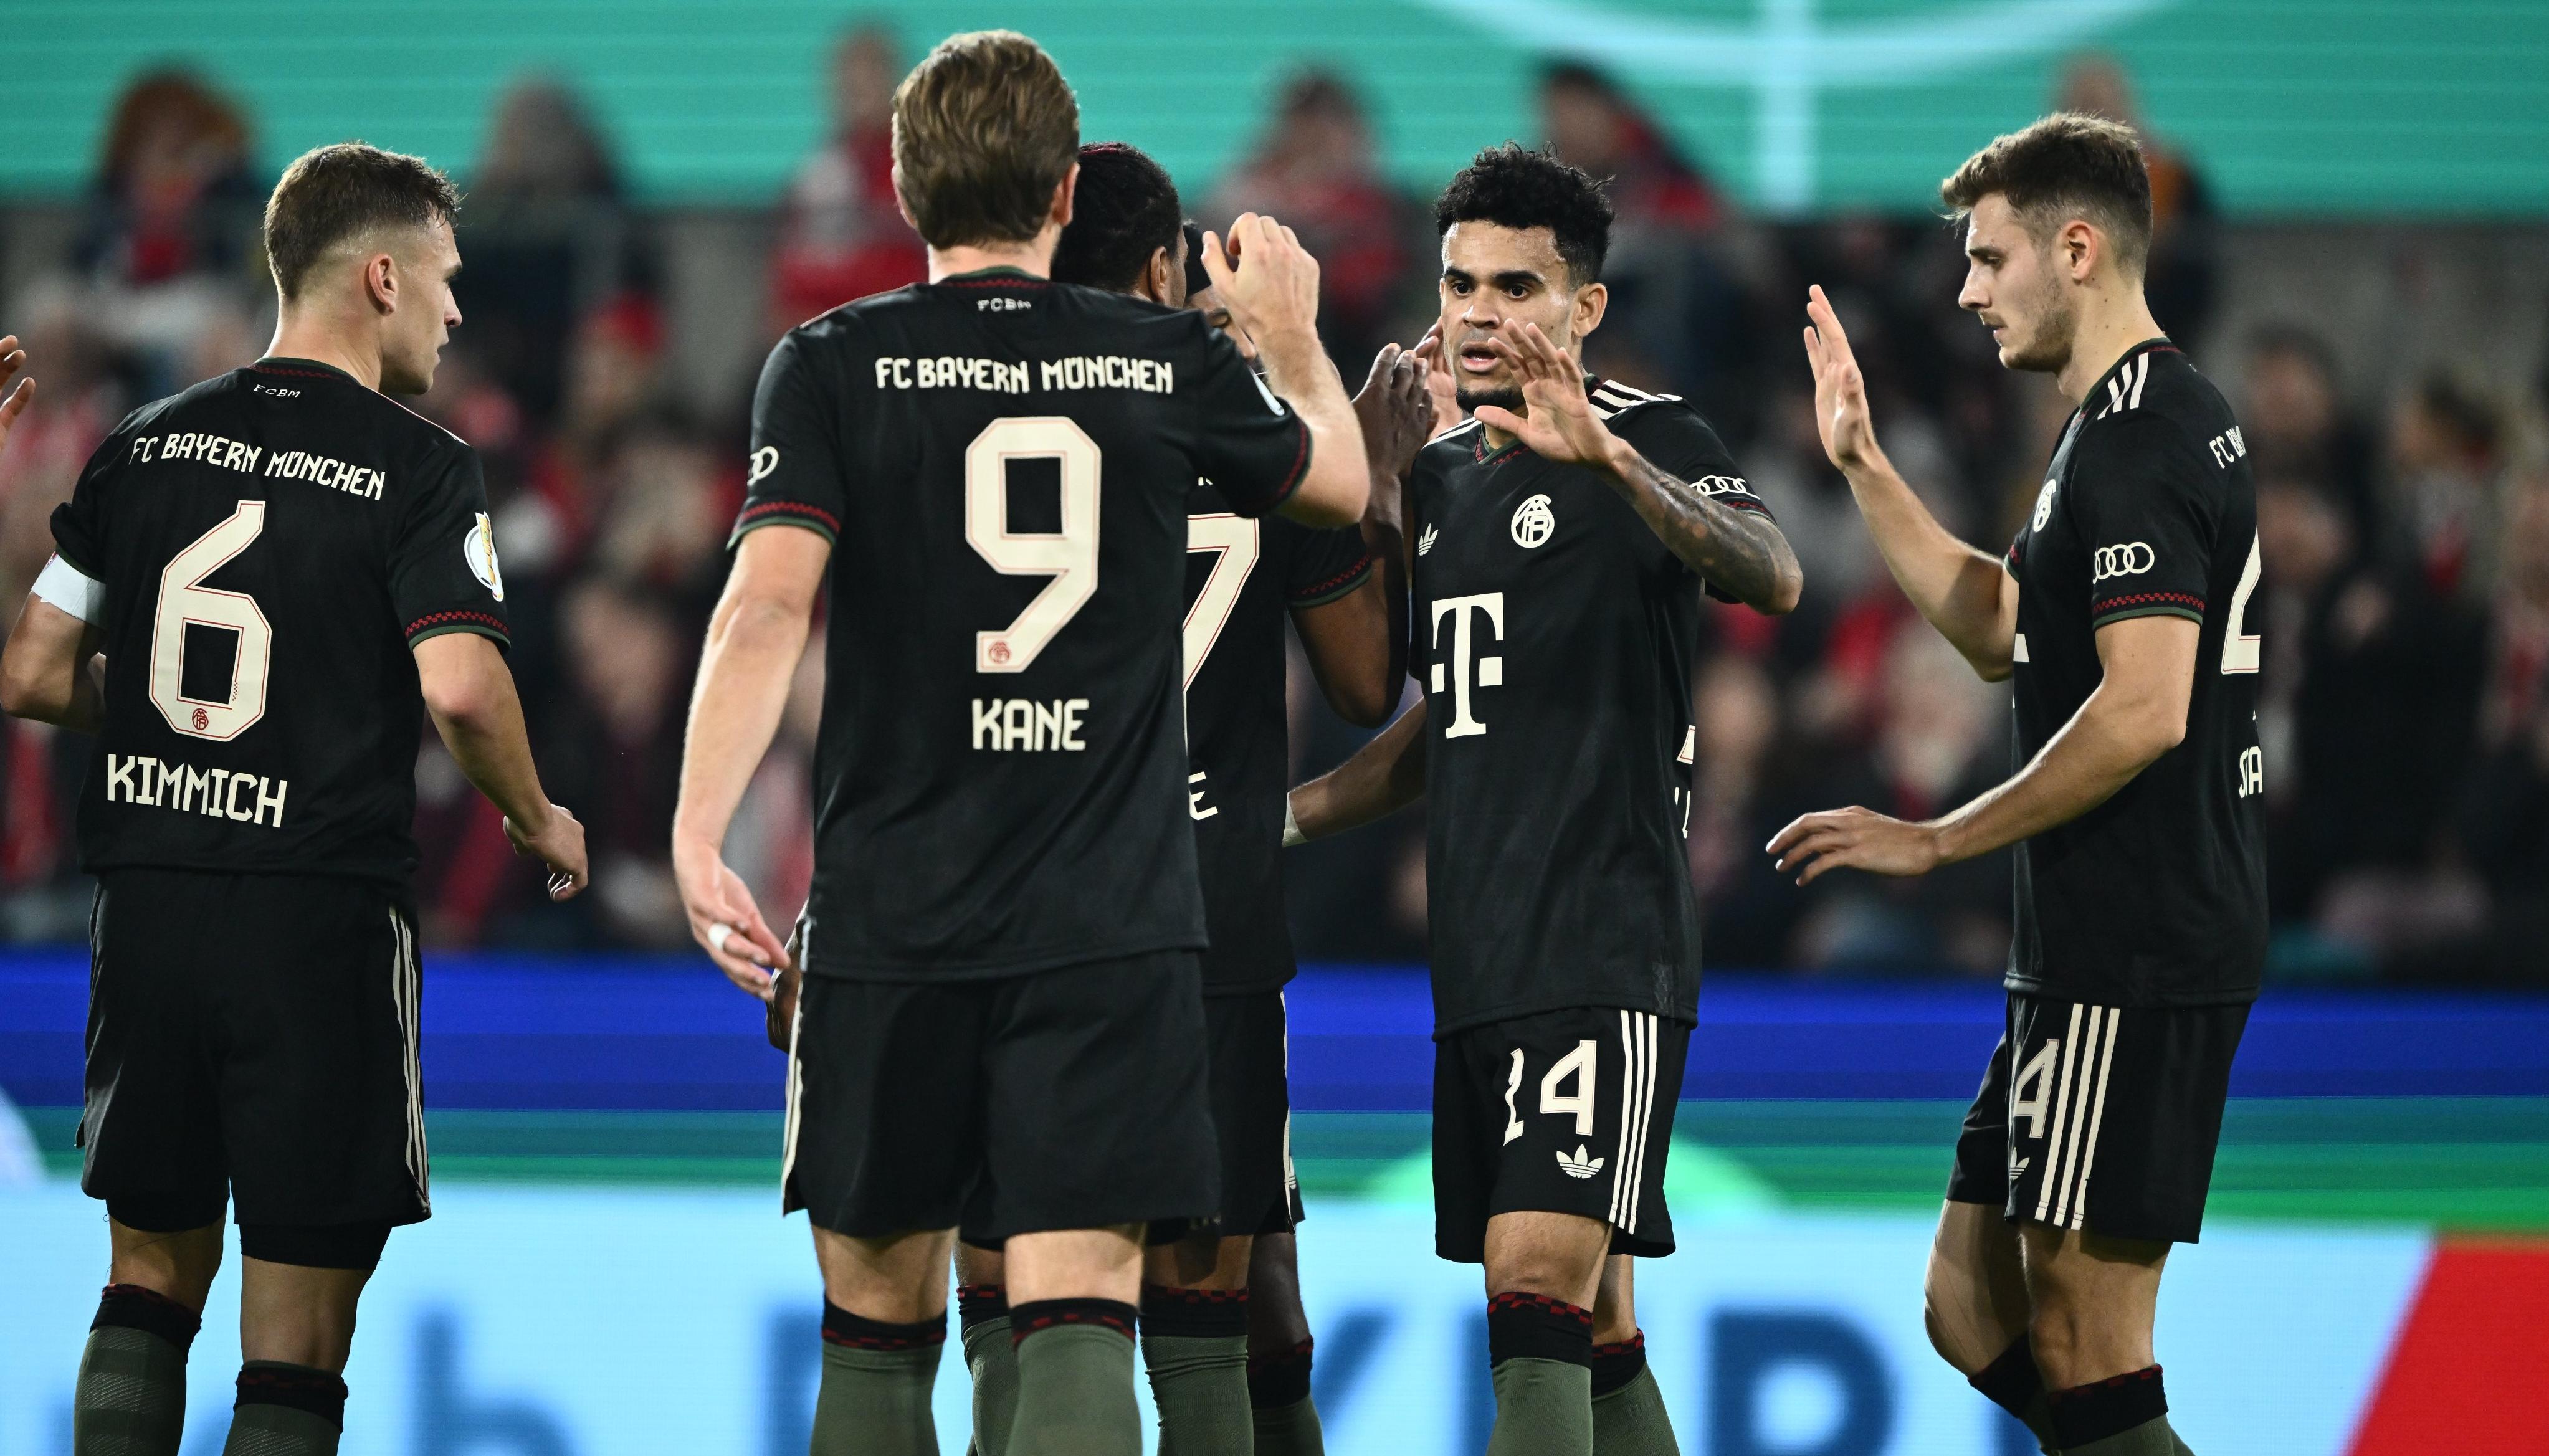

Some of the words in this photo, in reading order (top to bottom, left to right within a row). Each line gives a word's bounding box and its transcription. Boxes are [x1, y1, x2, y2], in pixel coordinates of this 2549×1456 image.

[976, 298, 1032, 312] FCBM
[253, 384, 301, 398] FCBM
[875, 358, 912, 389] FC
[917, 357, 1030, 394] BAYERN
[1041, 356, 1173, 394] MÜNCHEN
[128, 437, 159, 465] FC
[161, 433, 262, 473] BAYERN
[264, 451, 386, 501] MÜNCHEN
[2209, 435, 2235, 469] FC
[965, 416, 1101, 673] 9
[149, 500, 272, 741] 6
[972, 698, 1089, 751] KANE
[107, 753, 288, 828] KIMMICH
